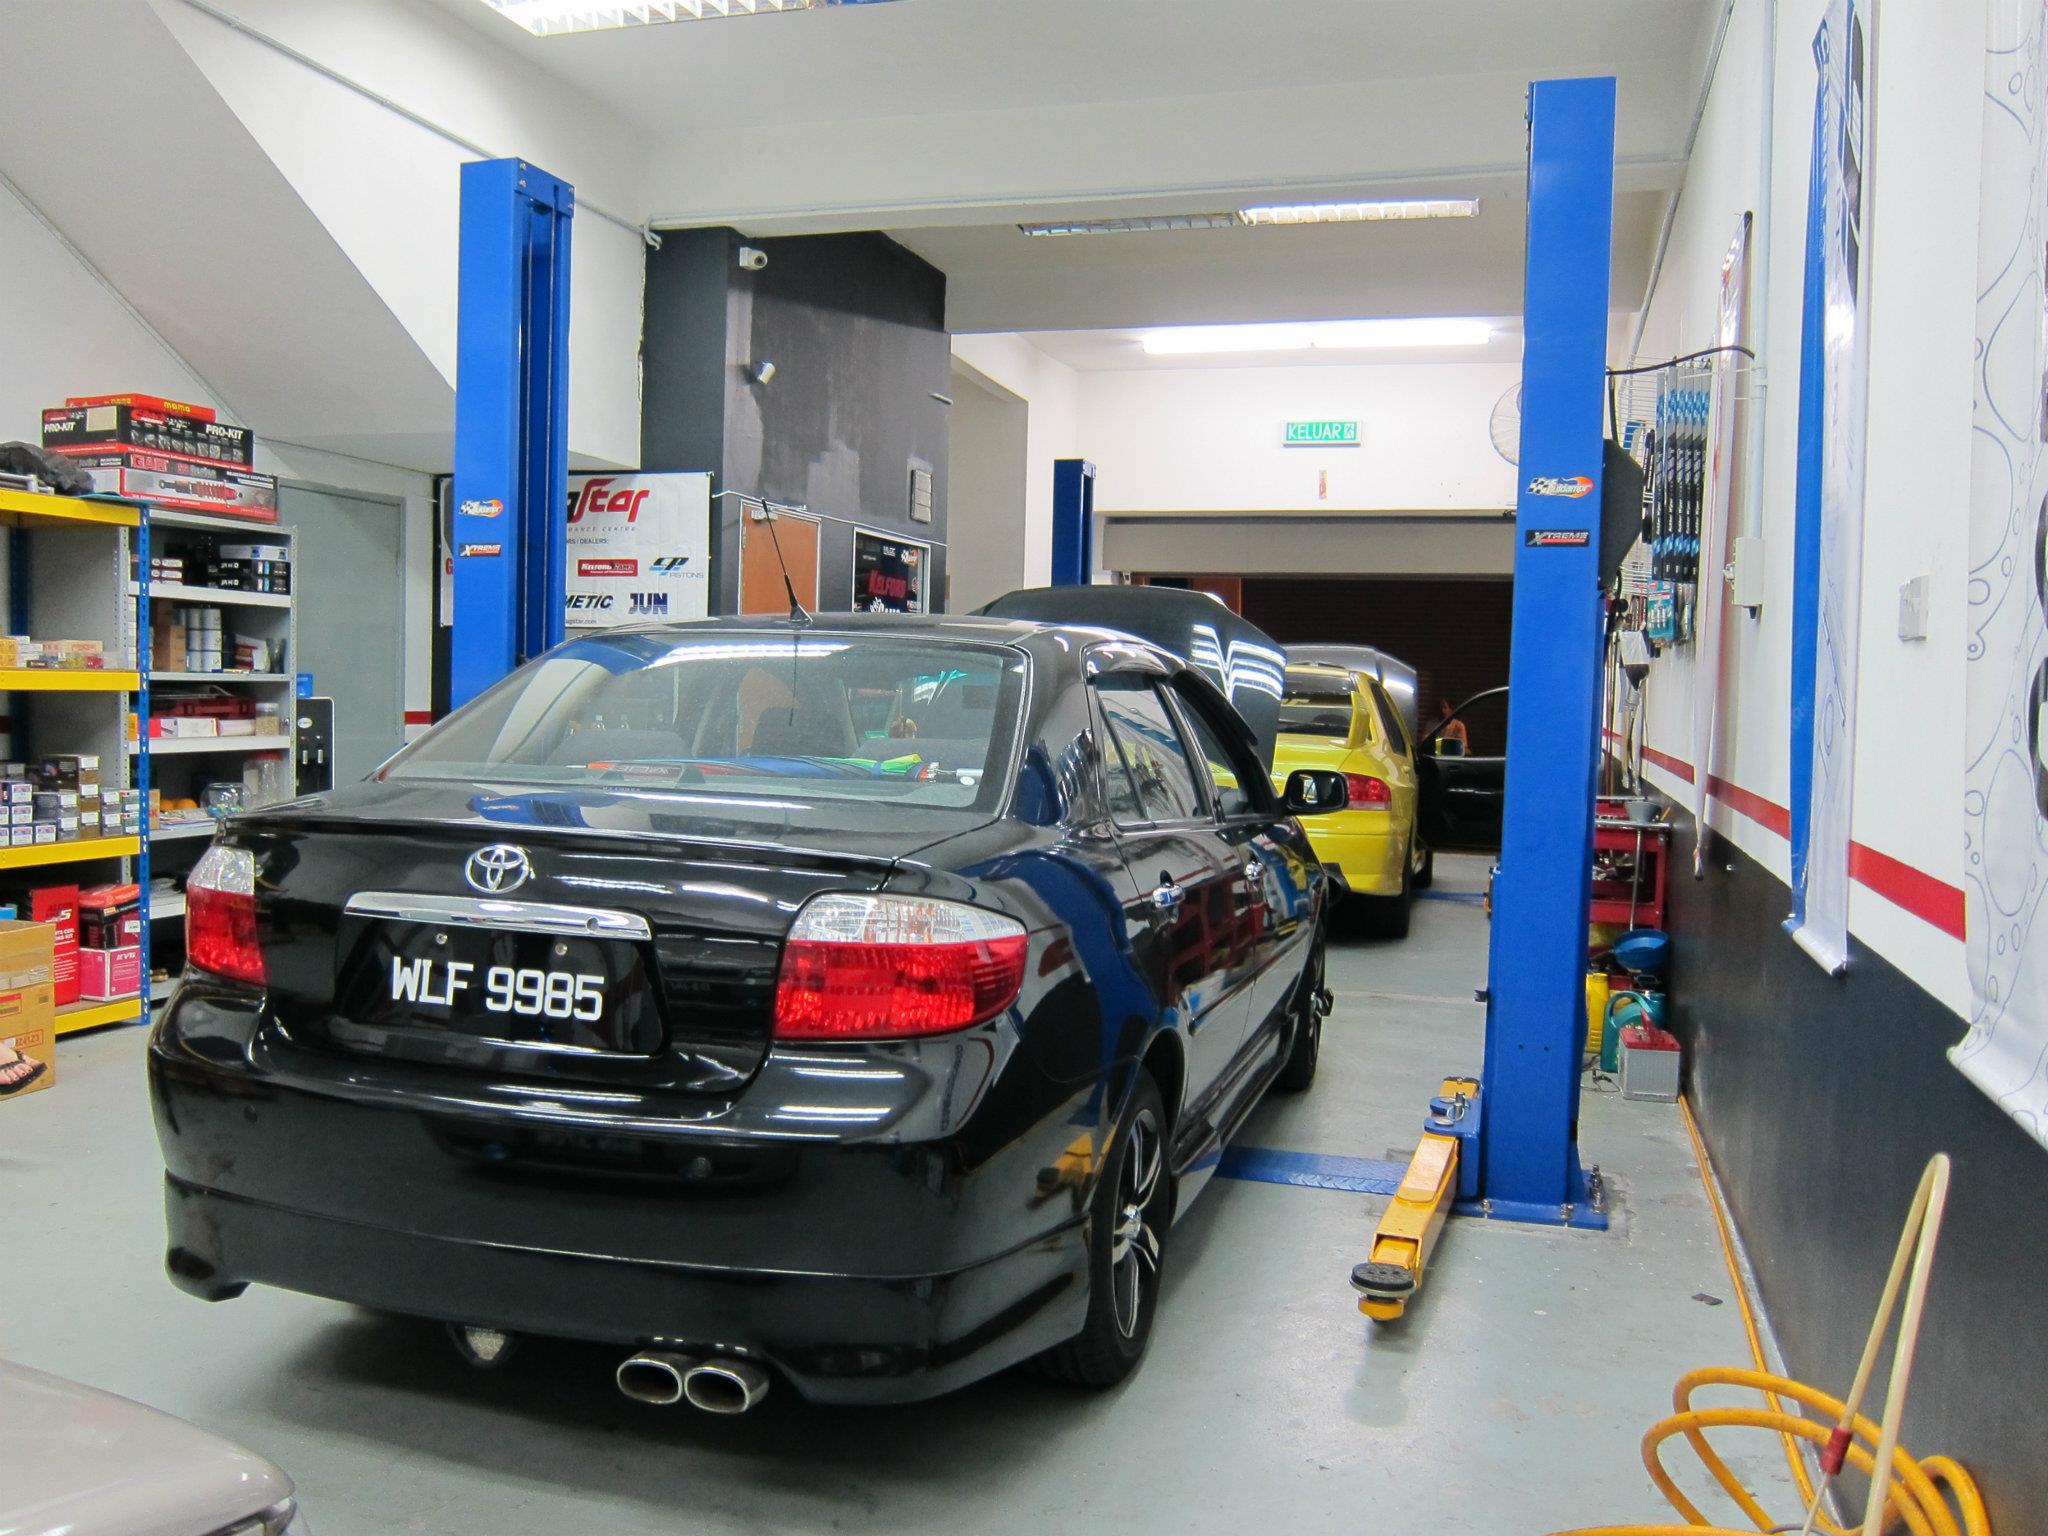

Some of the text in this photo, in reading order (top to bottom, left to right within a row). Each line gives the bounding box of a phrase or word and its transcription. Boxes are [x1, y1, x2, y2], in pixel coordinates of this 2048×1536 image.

[163, 401, 191, 413] momo
[44, 421, 76, 433] PRO-KIT
[205, 424, 244, 440] PRO-KIT
[1288, 423, 1342, 440] KELUAR
[1527, 531, 1588, 546] XTREME
[459, 544, 502, 557] XTREME
[628, 593, 668, 615] JUN
[392, 956, 605, 1021] WLF 9985
